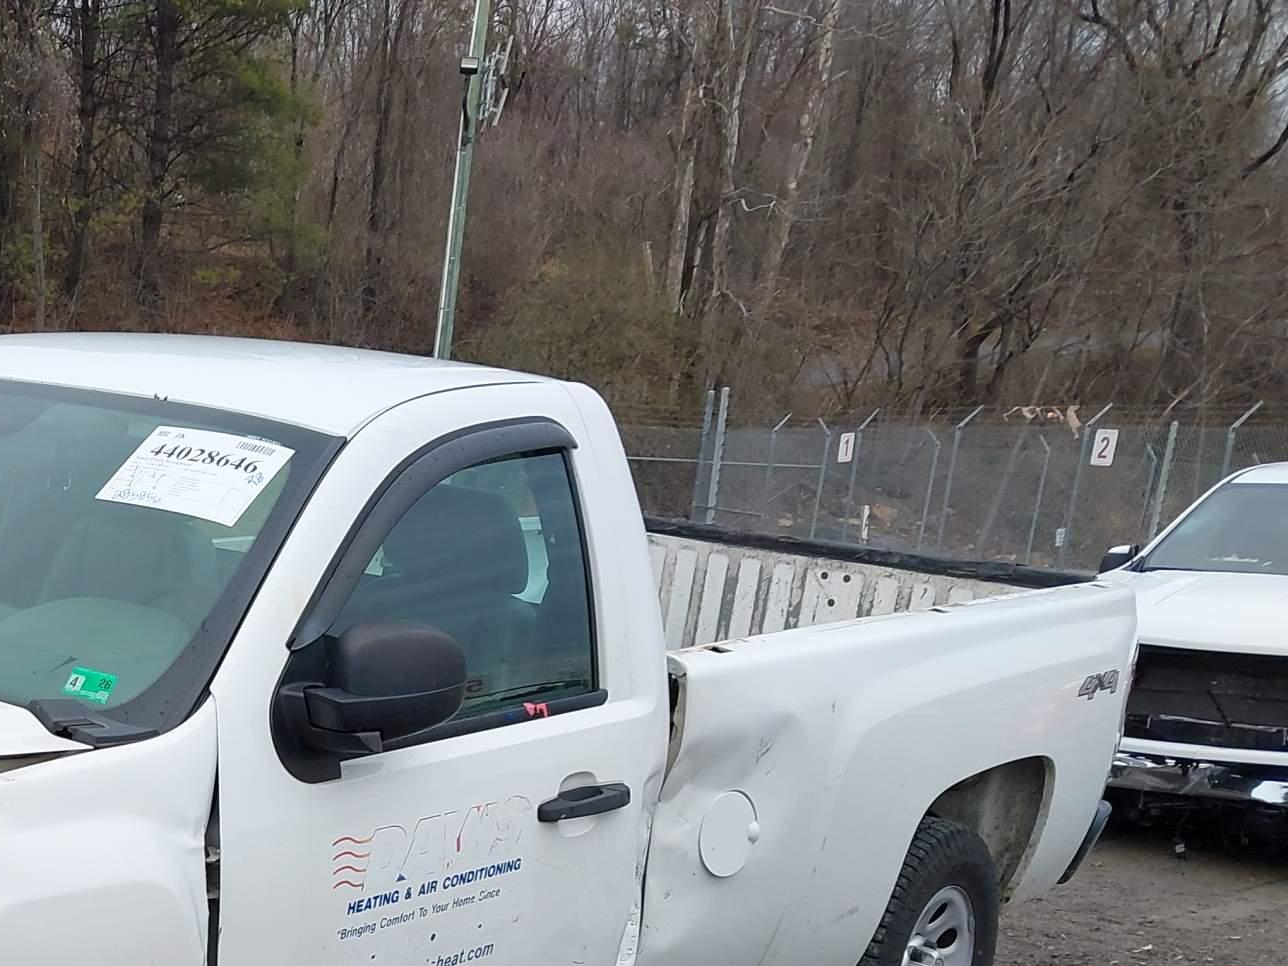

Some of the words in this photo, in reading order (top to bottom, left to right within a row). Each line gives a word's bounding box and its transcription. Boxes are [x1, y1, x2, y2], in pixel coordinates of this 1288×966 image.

[150, 442, 263, 474] 44028646
[843, 438, 850, 457] 1
[1097, 436, 1110, 460] 2
[69, 676, 80, 689] 4
[98, 678, 113, 690] 26
[346, 890, 399, 915] HEATING
[404, 889, 413, 900] &
[417, 879, 438, 898] AIR
[442, 858, 522, 890] CONDITIONING
[379, 911, 416, 930] Comfort
[418, 907, 429, 919] To
[431, 902, 450, 915] Your
[452, 896, 476, 912] Home
[478, 887, 501, 902] Since
